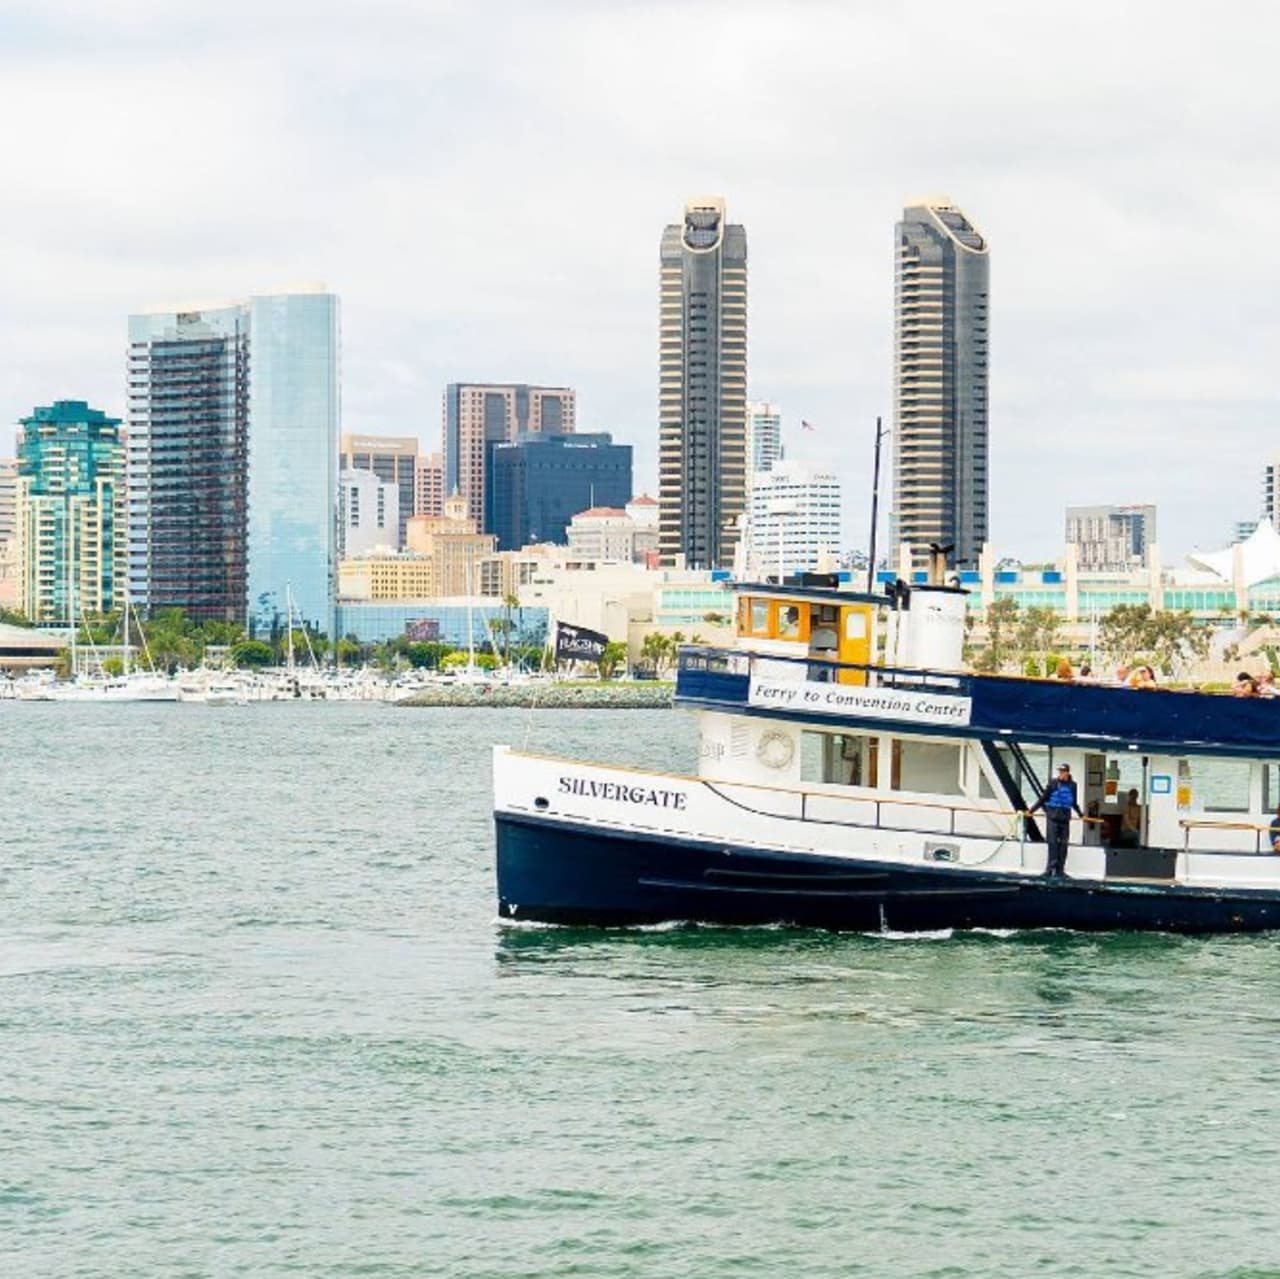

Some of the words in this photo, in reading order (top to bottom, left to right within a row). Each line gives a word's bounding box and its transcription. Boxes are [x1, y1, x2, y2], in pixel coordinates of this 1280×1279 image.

[755, 685, 797, 700] Ferry
[803, 687, 820, 701] to
[825, 690, 911, 711] Convention
[915, 700, 966, 717] Center
[558, 777, 688, 811] SILVERGATE
